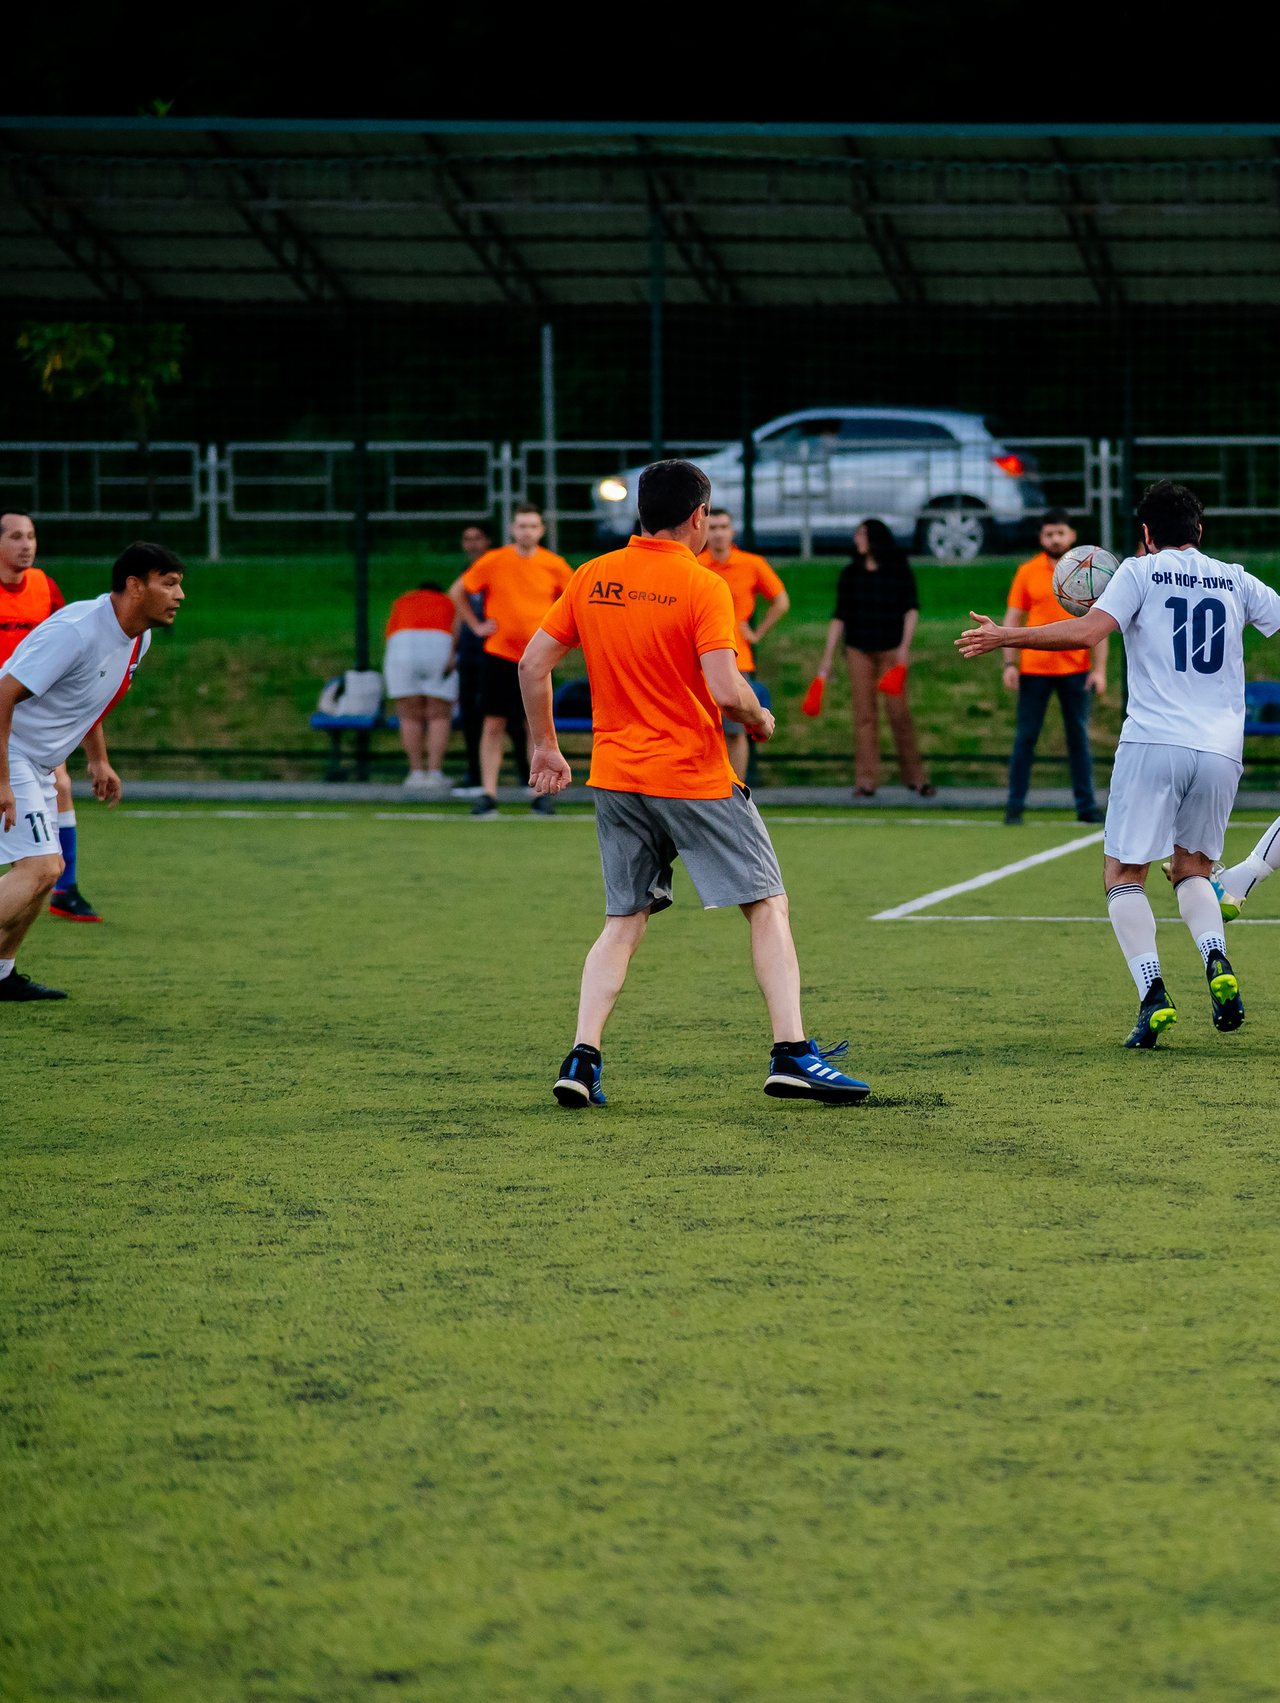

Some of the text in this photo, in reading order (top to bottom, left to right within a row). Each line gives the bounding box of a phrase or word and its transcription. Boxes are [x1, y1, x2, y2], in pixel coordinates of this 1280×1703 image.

[1151, 571, 1173, 585] ФК
[589, 581, 678, 606] AR GROUP
[1164, 596, 1227, 675] 10
[24, 812, 50, 843] 11
